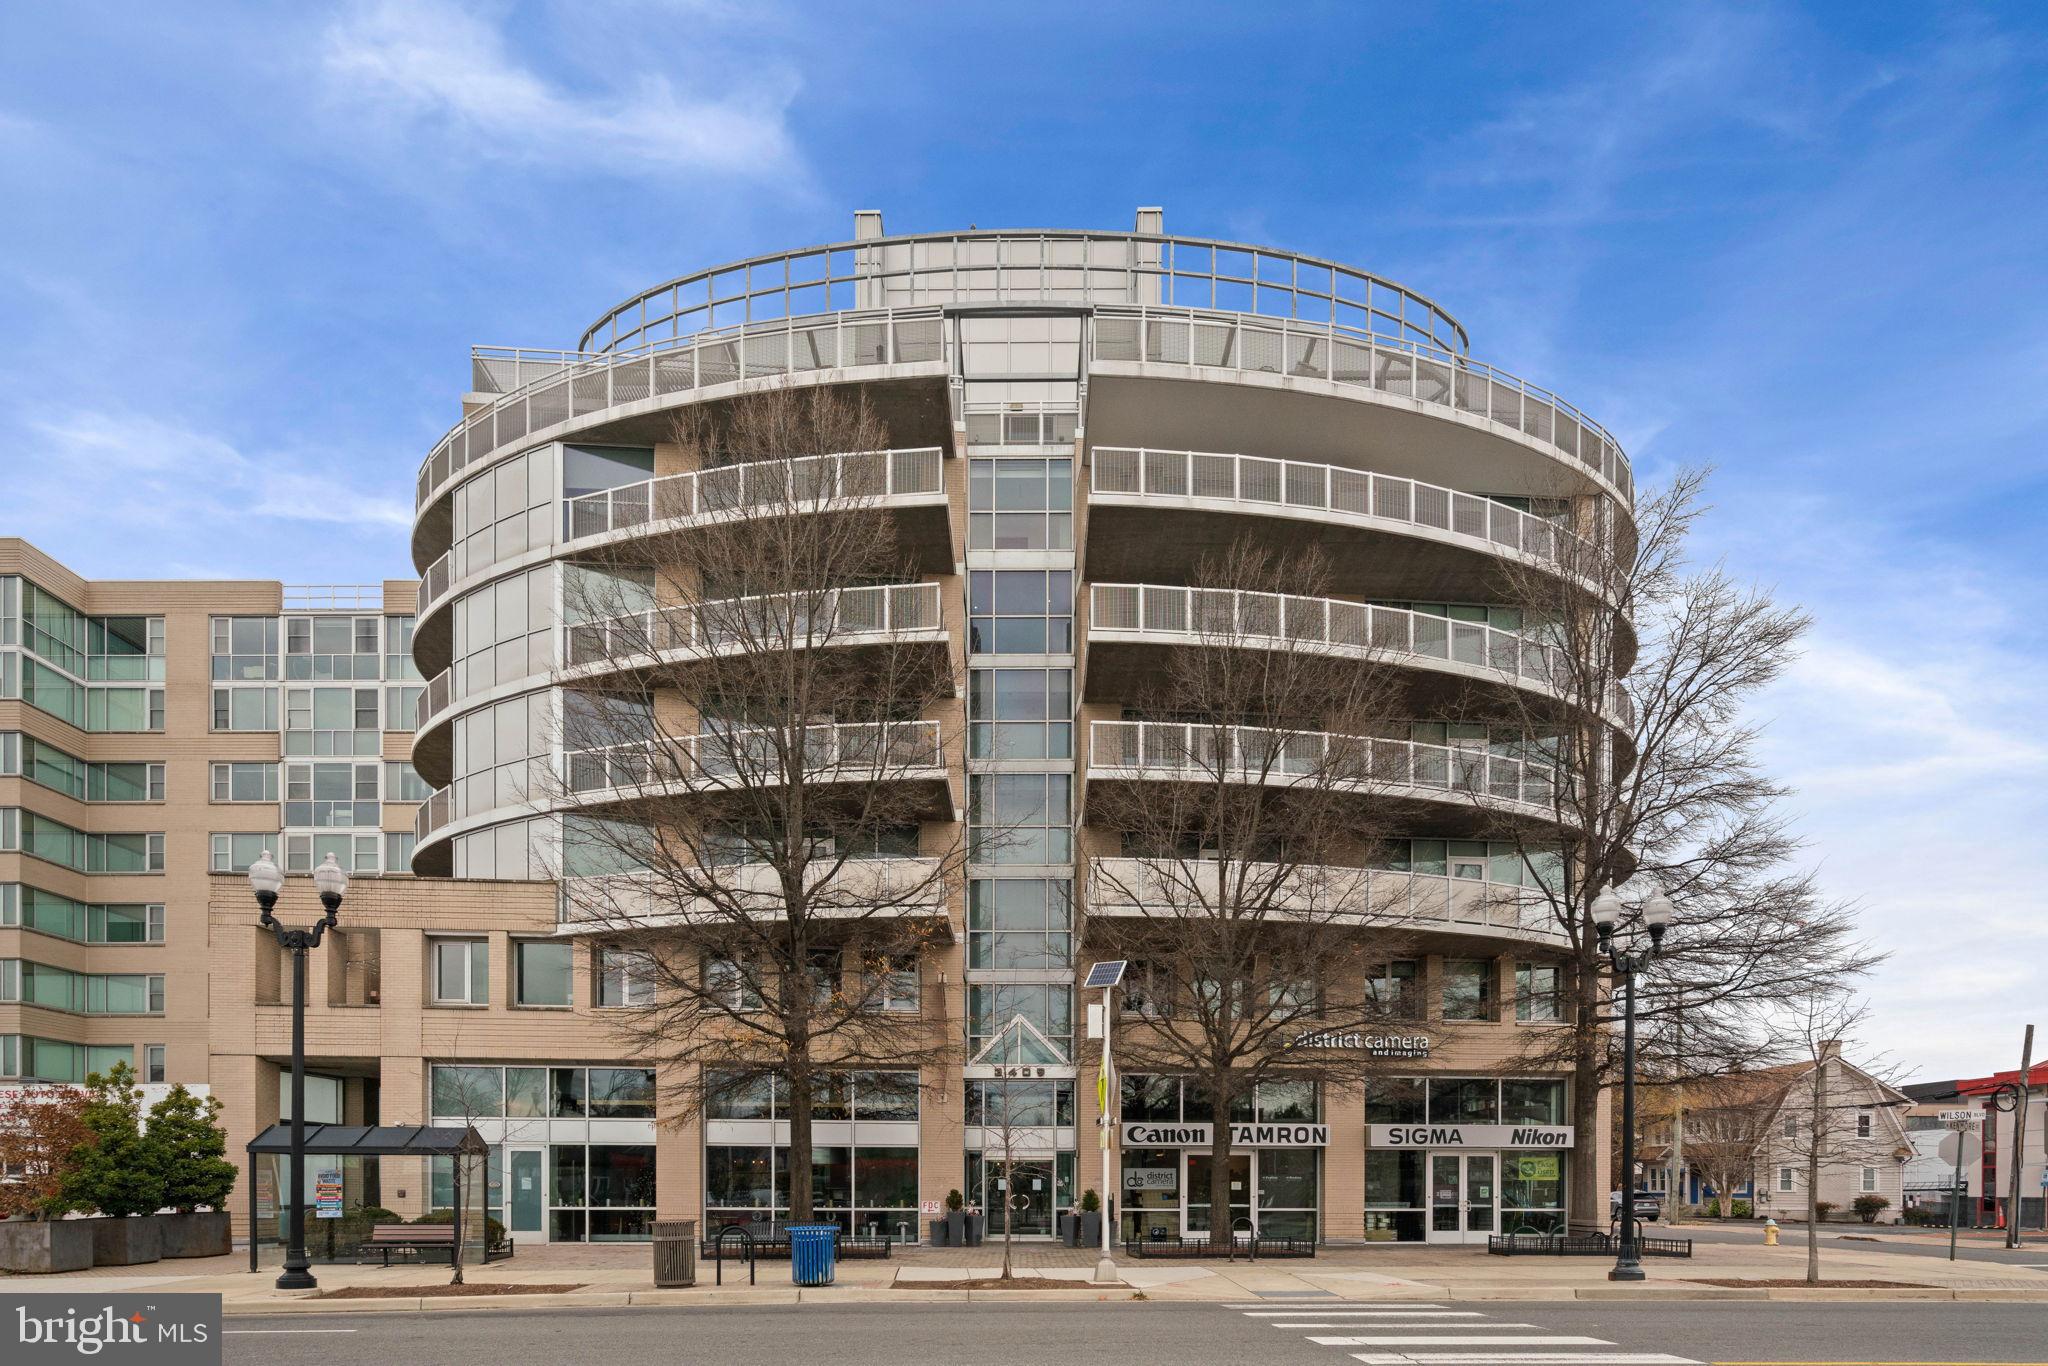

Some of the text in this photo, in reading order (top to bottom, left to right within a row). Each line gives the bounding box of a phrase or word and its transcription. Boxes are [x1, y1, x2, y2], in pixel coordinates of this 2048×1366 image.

[1296, 1030, 1361, 1048] district
[1364, 1035, 1429, 1049] camera
[1391, 1049, 1428, 1058] imaging
[1940, 1111, 1972, 1120] WILSON
[1127, 1125, 1205, 1143] Canon
[1388, 1128, 1463, 1145] SIGMA
[1511, 1128, 1568, 1145] Nikon
[1146, 1171, 1173, 1180] district
[922, 1201, 939, 1209] FDC
